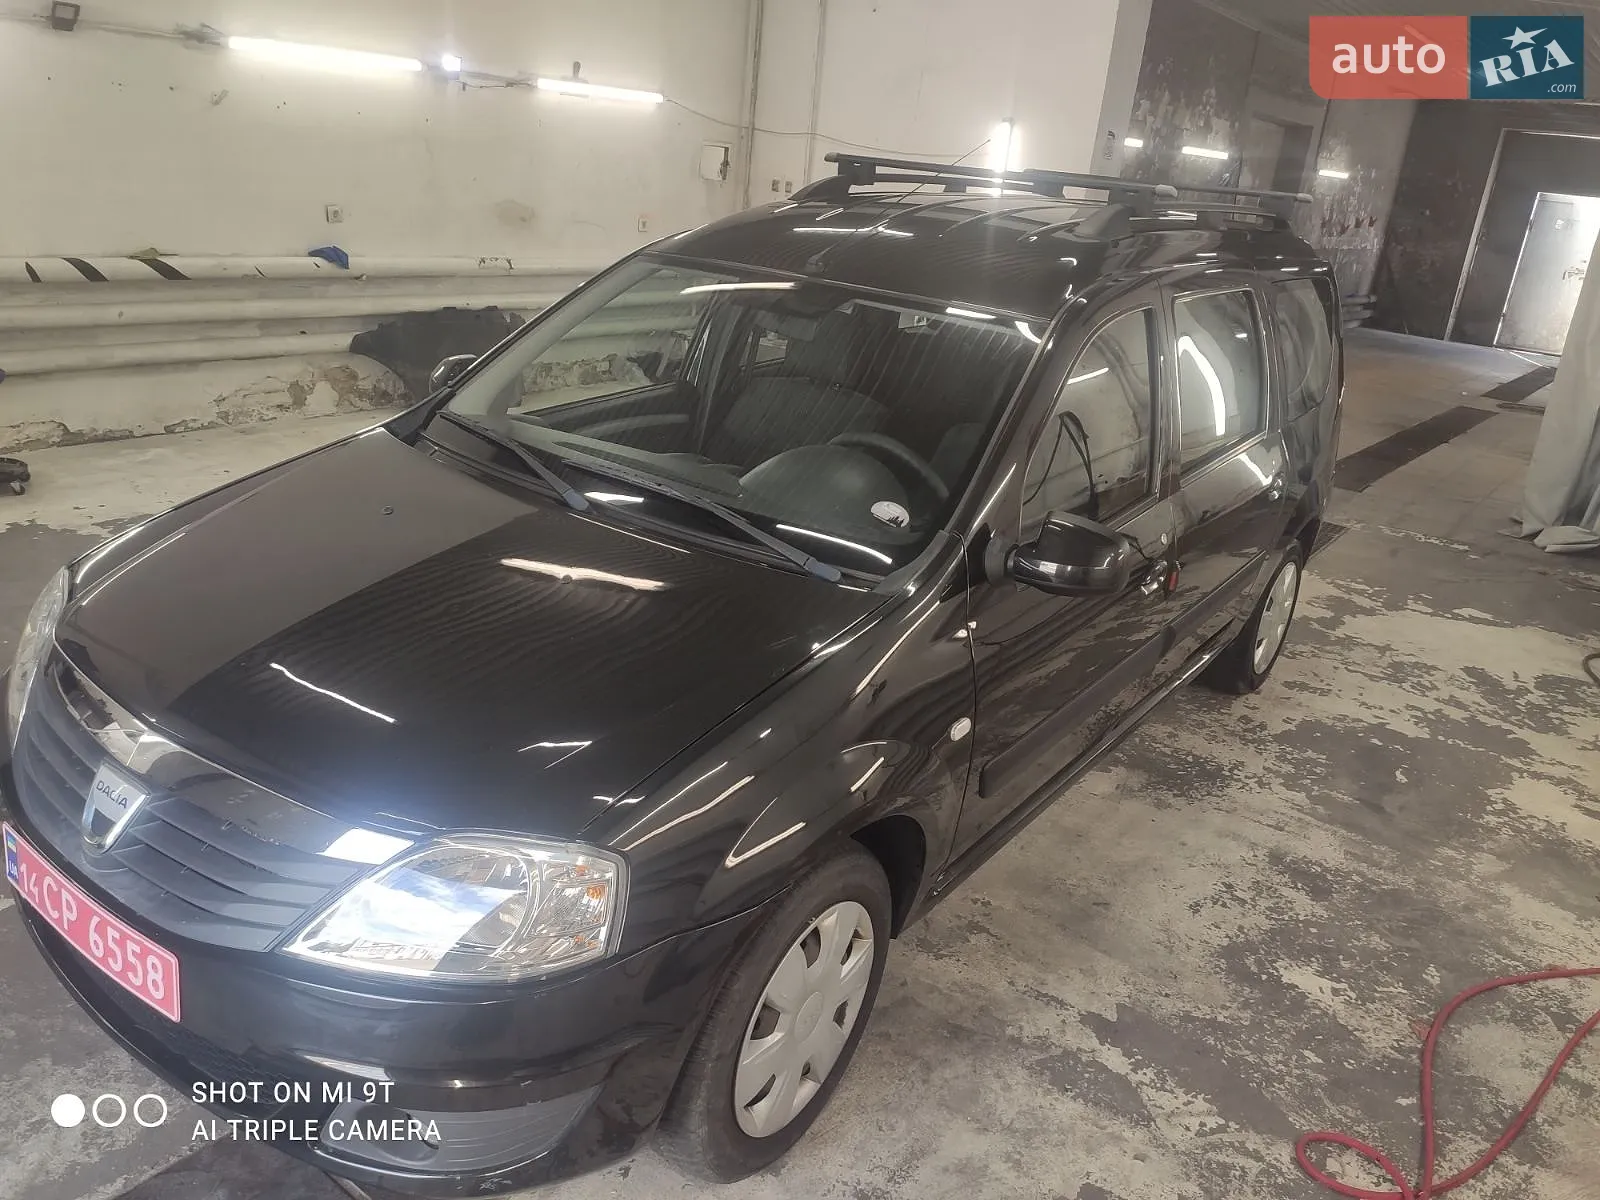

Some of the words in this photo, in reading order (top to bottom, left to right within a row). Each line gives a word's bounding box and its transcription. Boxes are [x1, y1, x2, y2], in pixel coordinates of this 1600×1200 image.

[96, 780, 128, 809] DACIA
[9, 860, 19, 879] UA
[89, 915, 165, 1000] 6558
